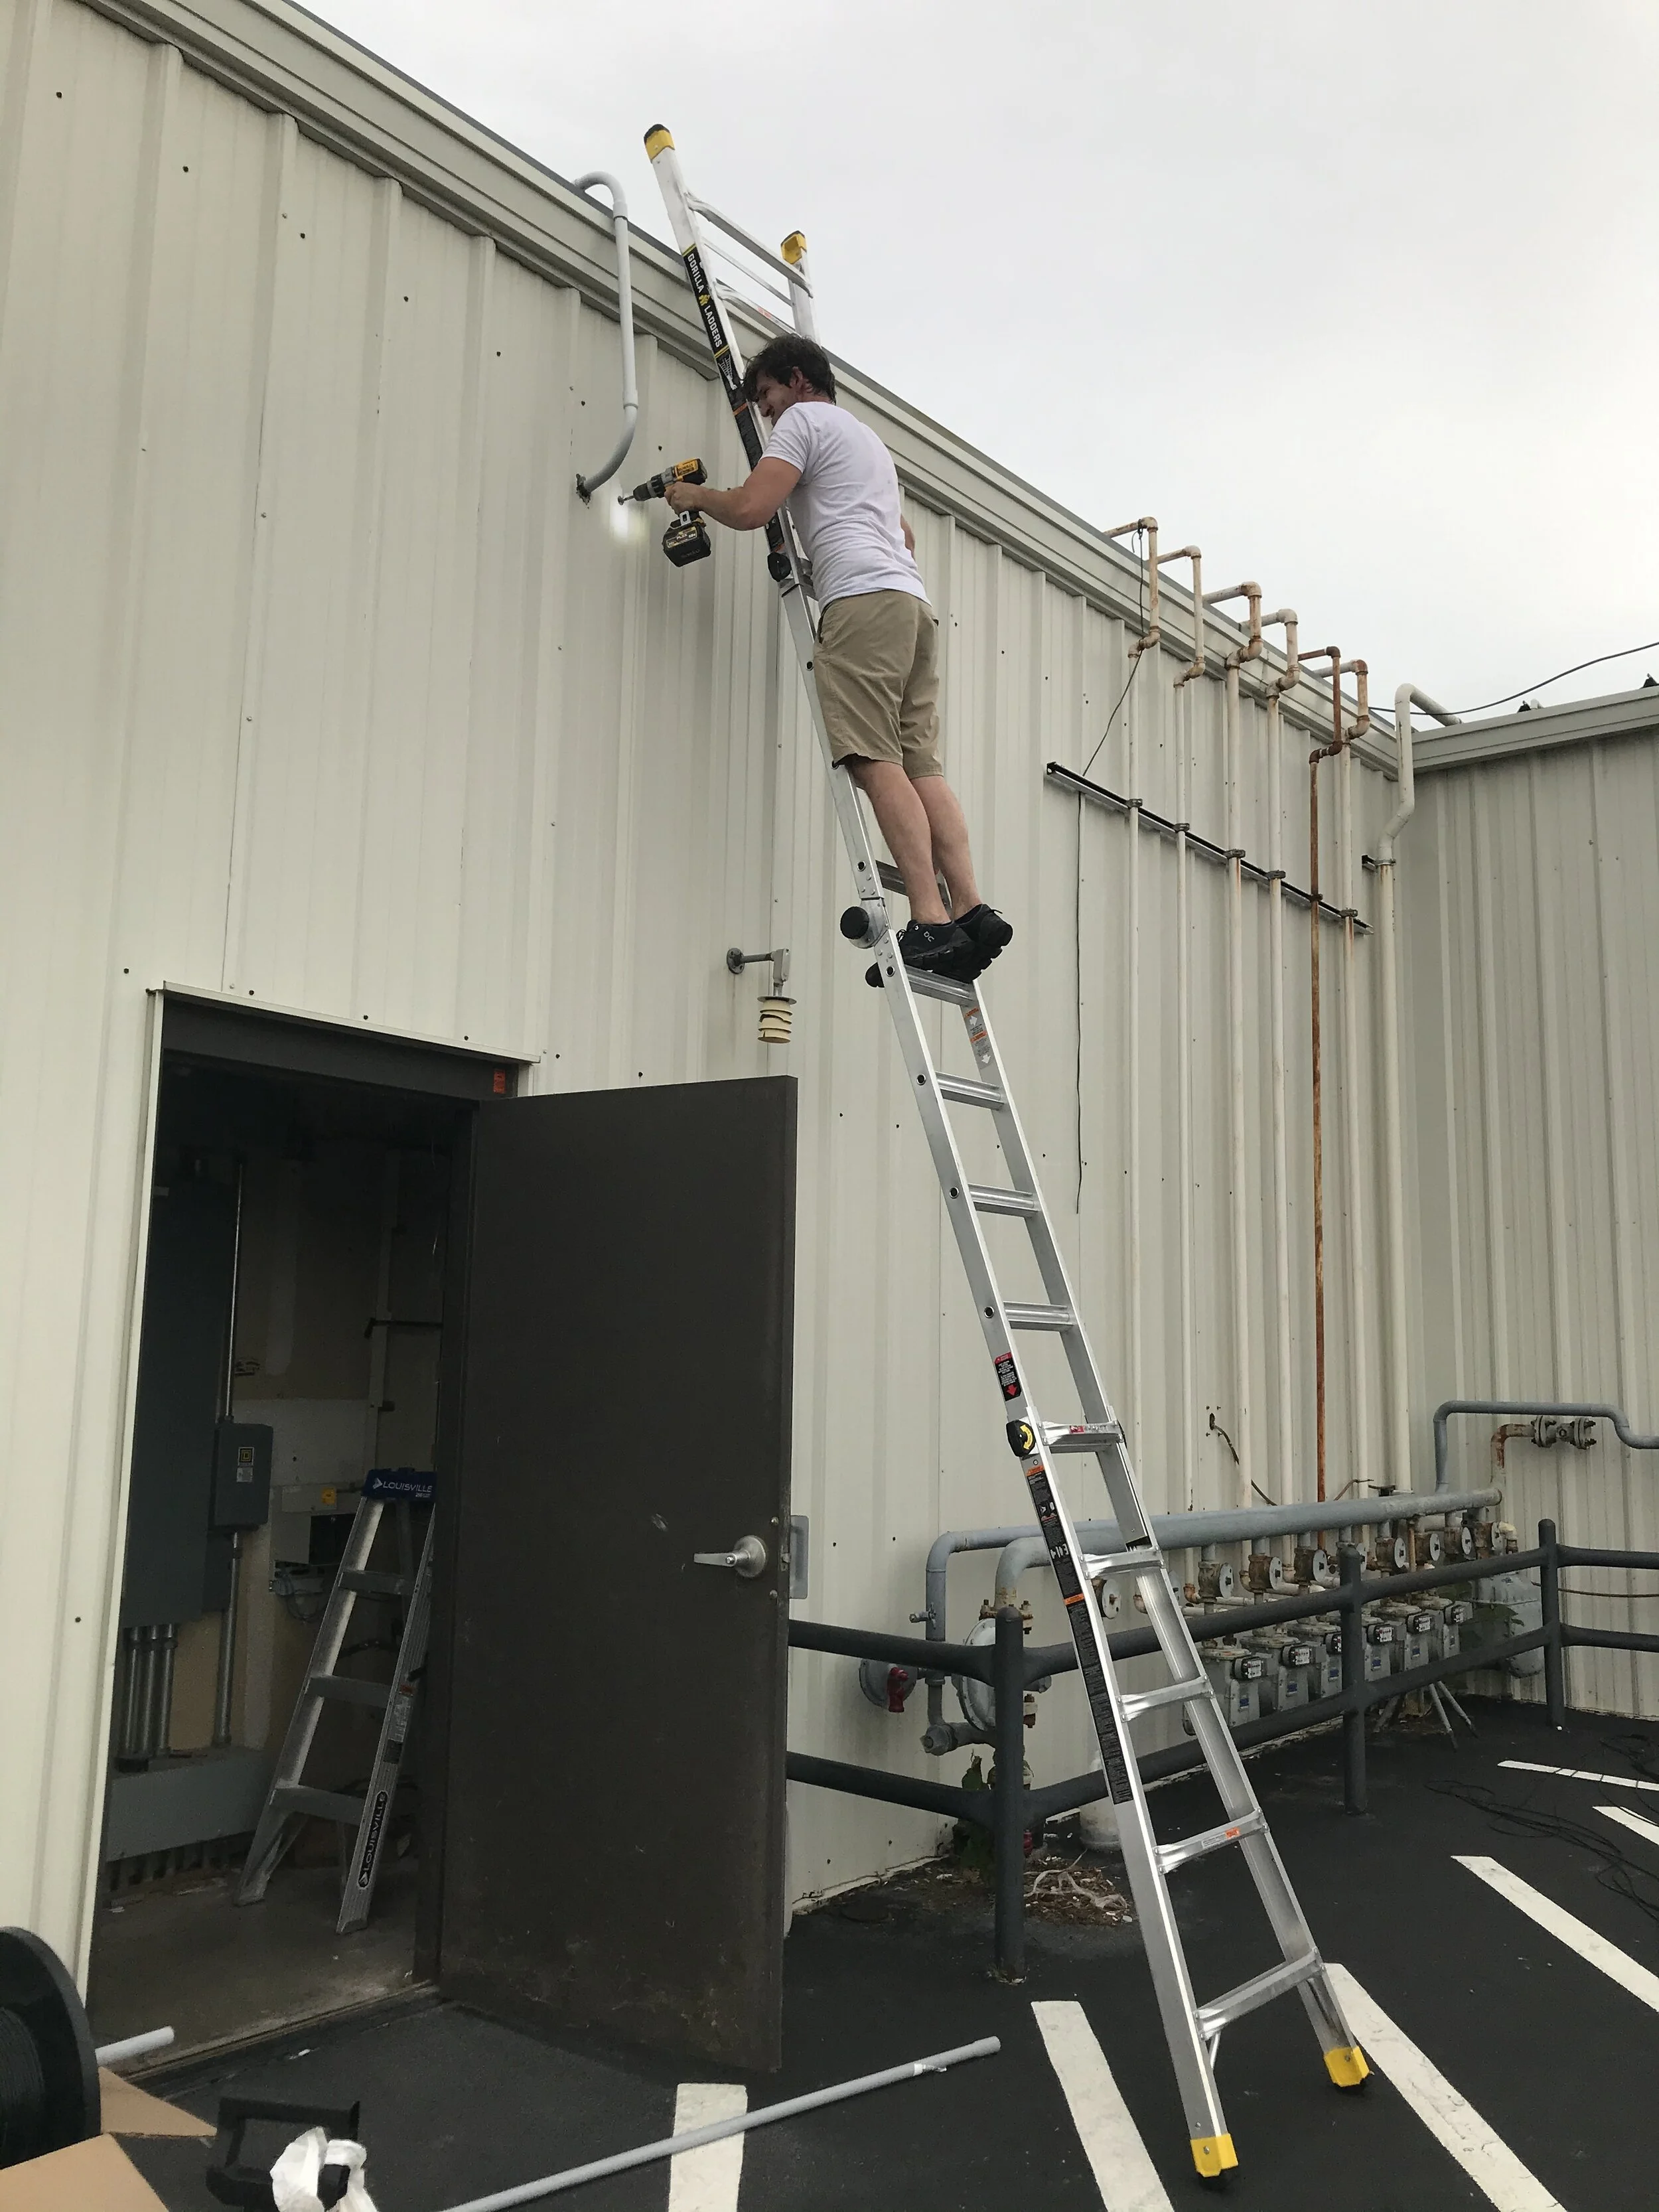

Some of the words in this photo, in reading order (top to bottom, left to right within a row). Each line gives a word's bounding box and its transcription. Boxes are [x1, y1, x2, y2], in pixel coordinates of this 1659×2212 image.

[687, 253, 705, 293] GORILLA
[704, 305, 723, 348] LADDERS
[382, 1481, 433, 1493] LOUISVILLE
[363, 1793, 386, 1871] LOUISVILLE
